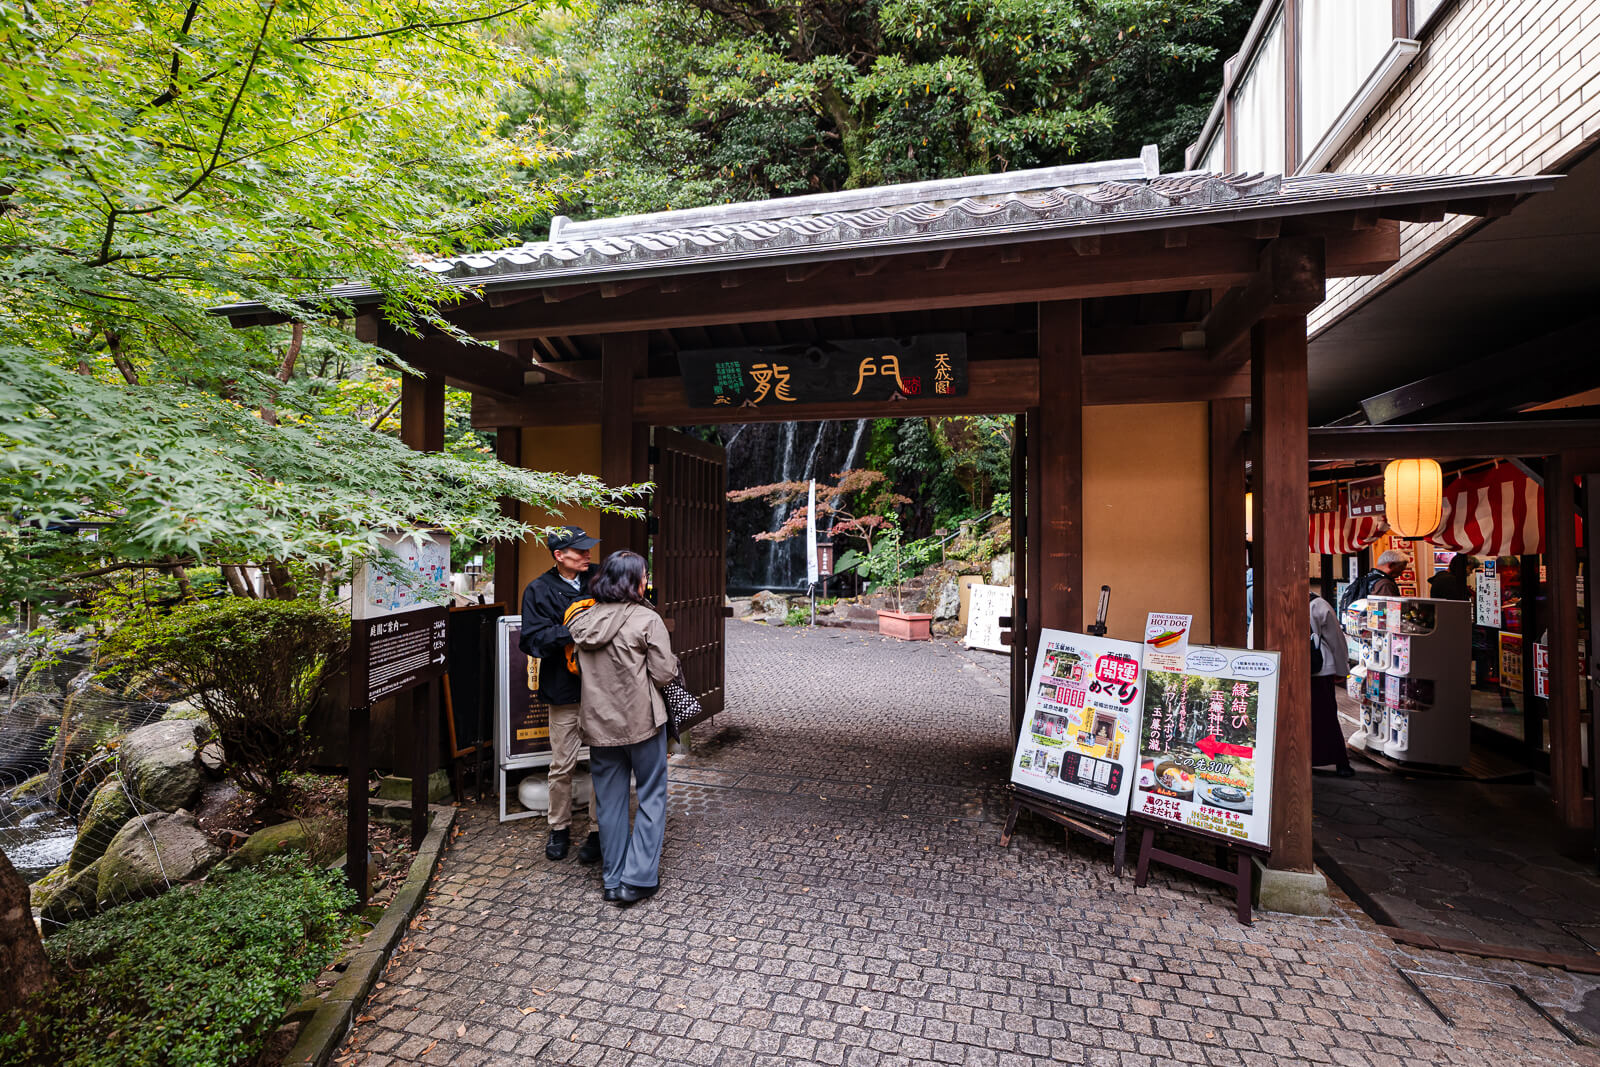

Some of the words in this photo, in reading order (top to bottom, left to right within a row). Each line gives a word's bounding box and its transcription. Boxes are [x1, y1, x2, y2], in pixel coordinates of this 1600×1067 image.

[370, 619, 399, 637] 庭園ご案内
[1150, 618, 1168, 626] HOT
[1097, 658, 1137, 683] 開運
[1088, 680, 1138, 706] めぐり
[1207, 690, 1225, 737] 玉簾神社
[1231, 682, 1250, 729] 縁結び
[1164, 684, 1177, 754] パワースポット
[1174, 756, 1233, 775] この先30M
[1142, 804, 1182, 822] たまだれ庵
[1200, 806, 1240, 821] 好評営業中
